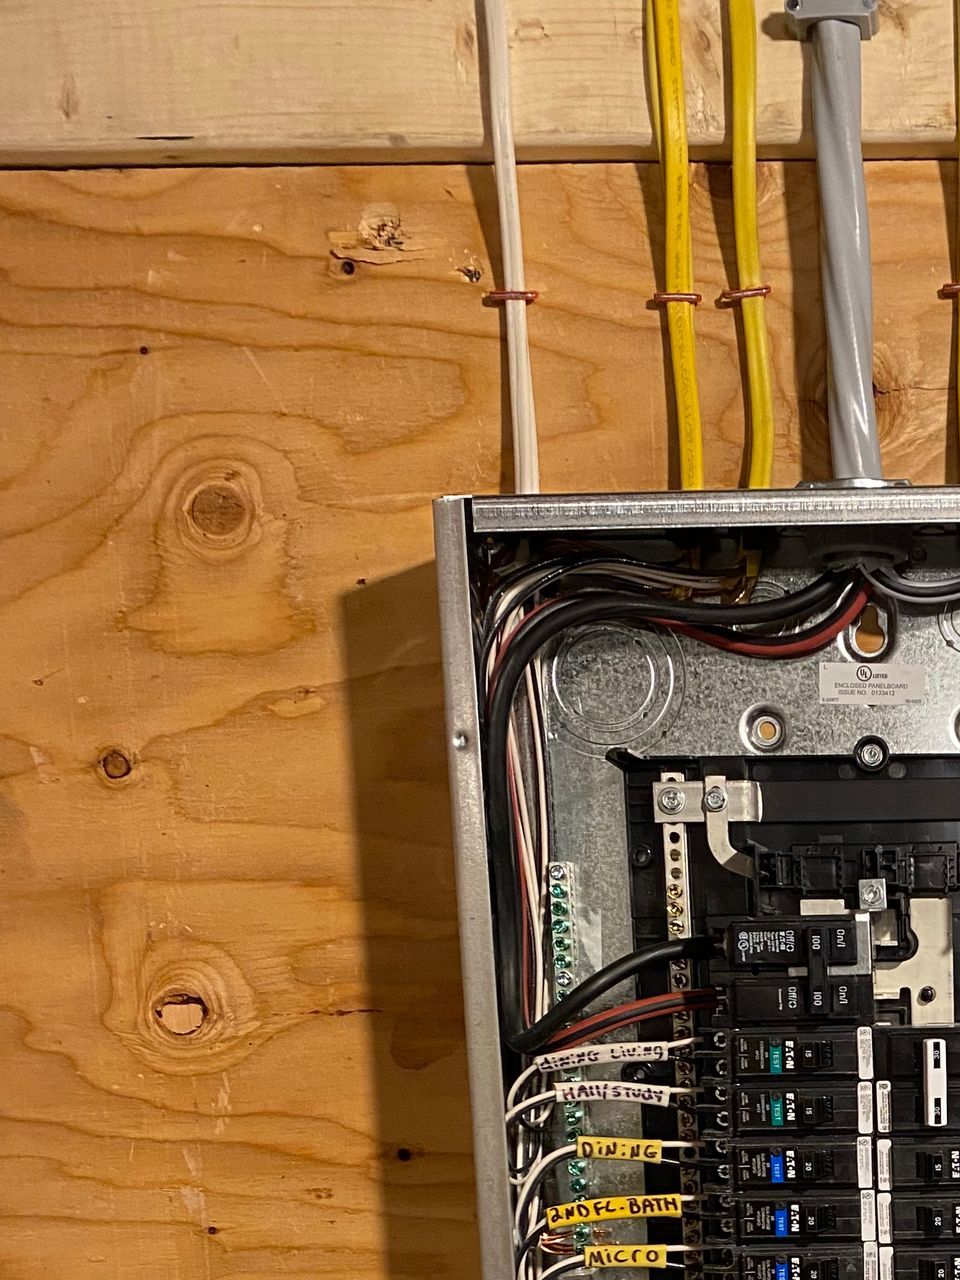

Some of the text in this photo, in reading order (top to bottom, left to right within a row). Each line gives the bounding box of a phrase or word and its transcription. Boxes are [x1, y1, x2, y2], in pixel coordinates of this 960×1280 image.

[834, 682, 867, 690] ENCLOSED
[812, 935, 821, 950] 100
[813, 991, 822, 1006] 100
[805, 1162, 812, 1172] 20
[808, 1216, 814, 1225] 20
[935, 1217, 941, 1226] 20
[810, 1270, 817, 1279] 20
[938, 1268, 944, 1278] 20
